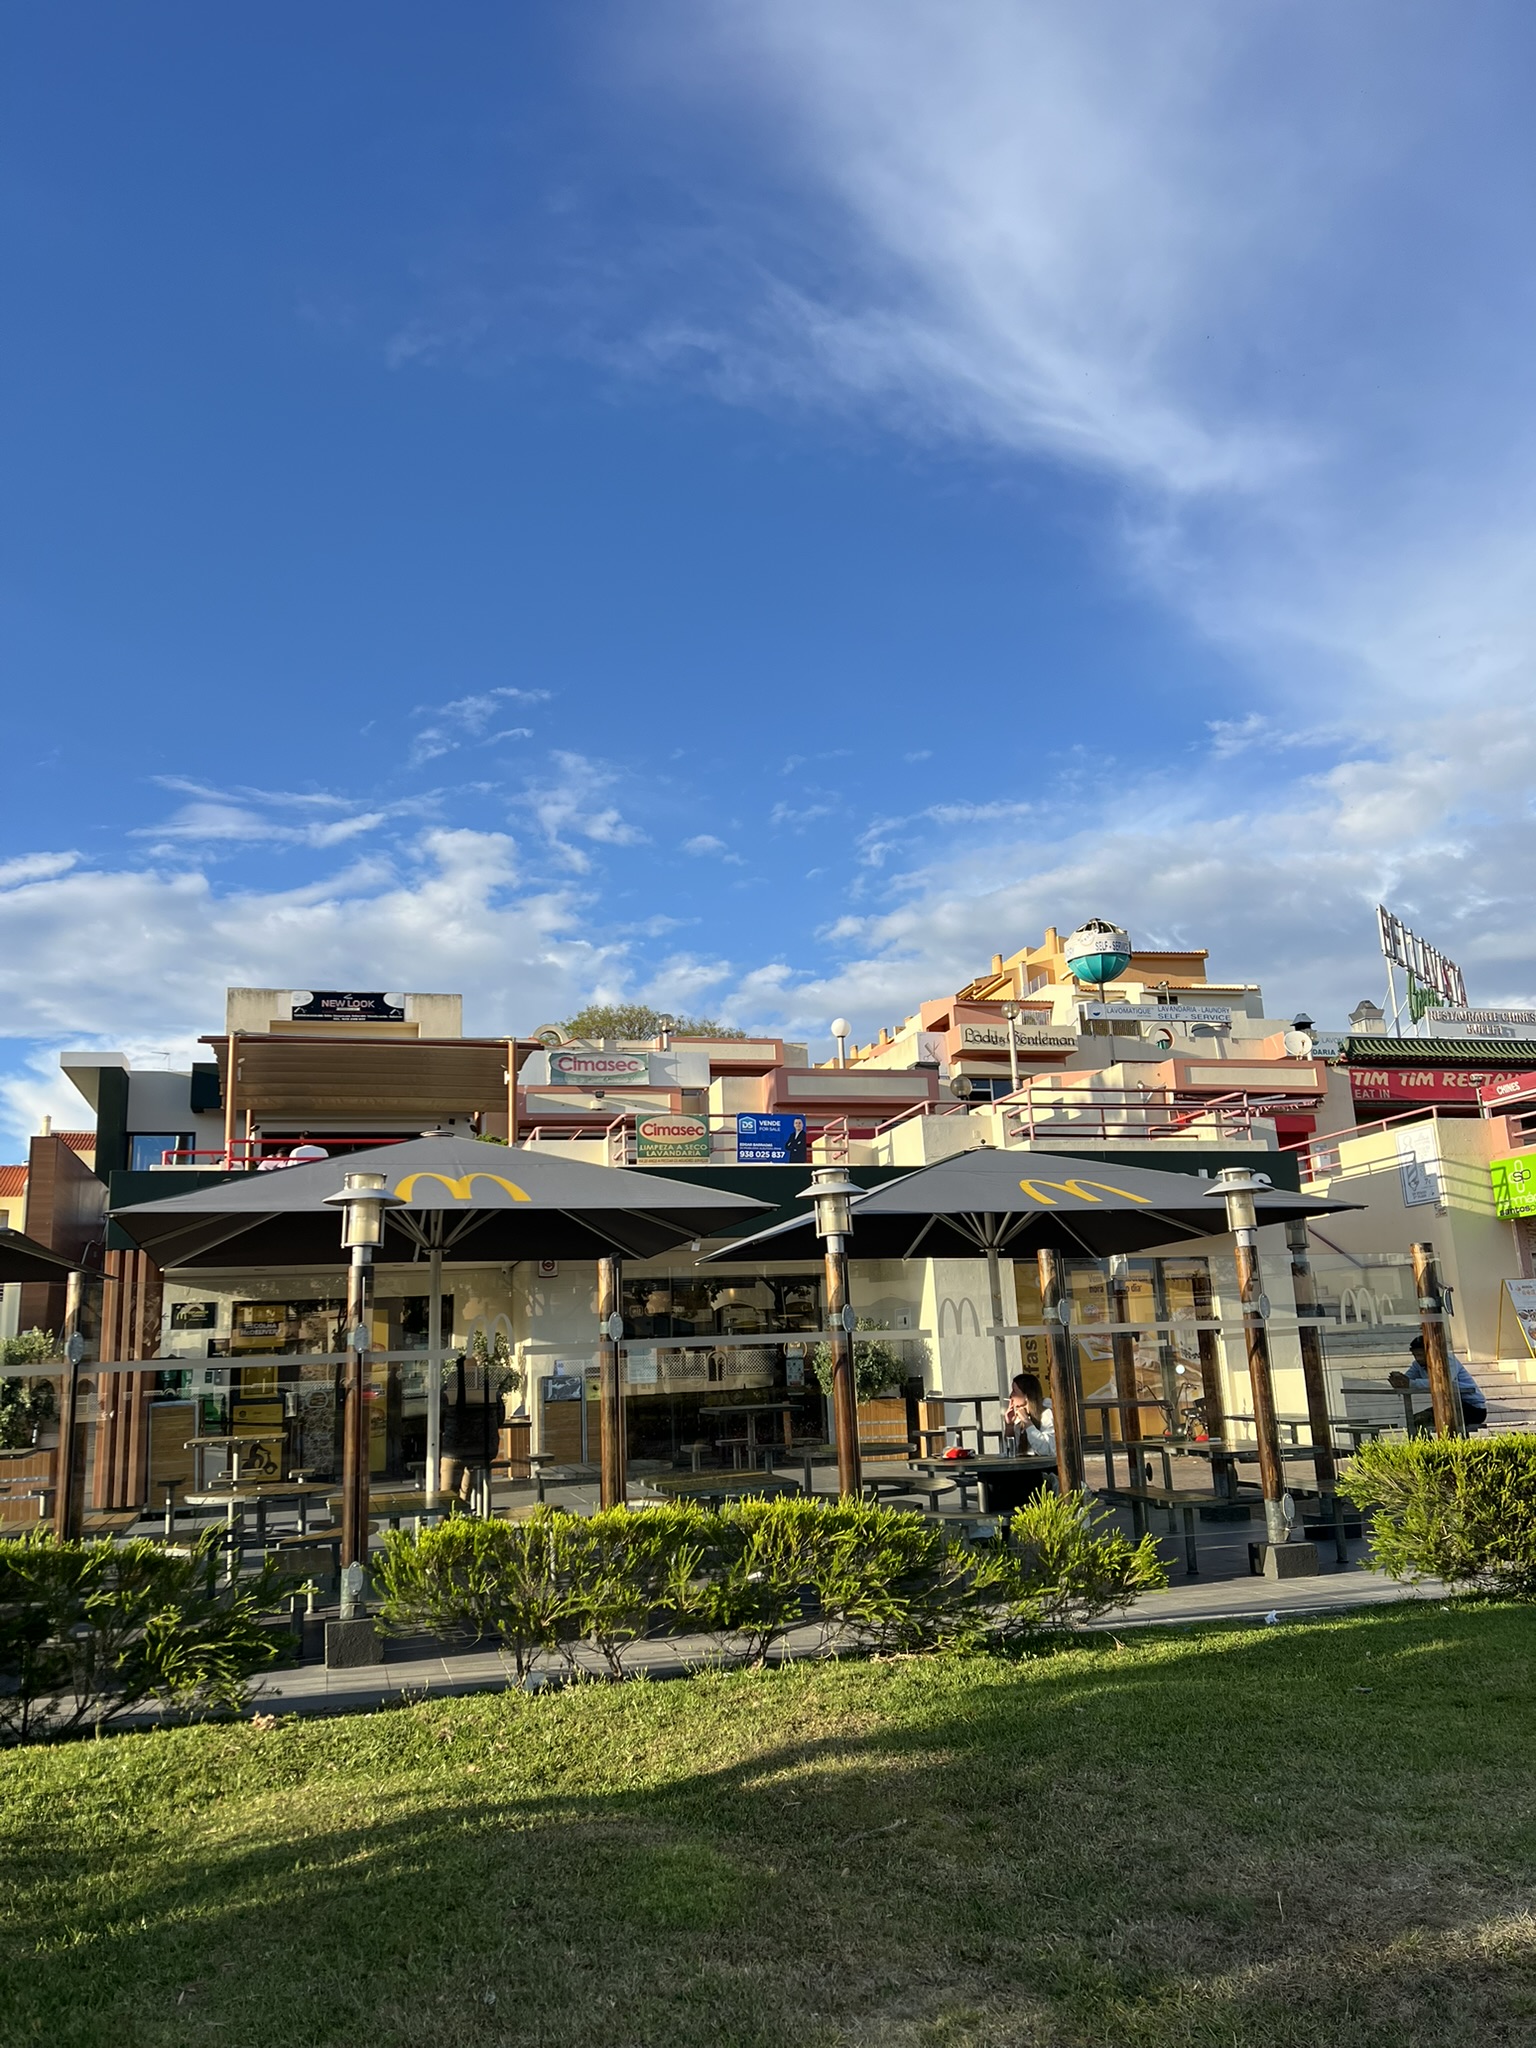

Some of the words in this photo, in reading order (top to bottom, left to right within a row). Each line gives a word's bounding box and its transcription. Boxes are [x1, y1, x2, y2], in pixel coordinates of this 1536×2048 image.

[321, 1000, 345, 1008] NEW
[347, 1000, 375, 1008] LOOK
[1107, 1007, 1151, 1015] LAVOMATIQUE
[1190, 1013, 1231, 1021] SERVICE
[1429, 1010, 1498, 1022] RESTAURANTE
[964, 1027, 998, 1046] Lady
[558, 1056, 639, 1072] Cimasec
[1352, 1071, 1389, 1087] TIM
[1398, 1071, 1435, 1087] TIM
[1354, 1089, 1375, 1099] EAT
[1379, 1089, 1390, 1099] IN
[642, 1123, 705, 1137] Cimasec
[742, 1121, 754, 1130] DS
[639, 1144, 674, 1152] LIMPEZA
[739, 1150, 754, 1158] 938
[755, 1150, 771, 1158] 025
[771, 1151, 786, 1159] 837
